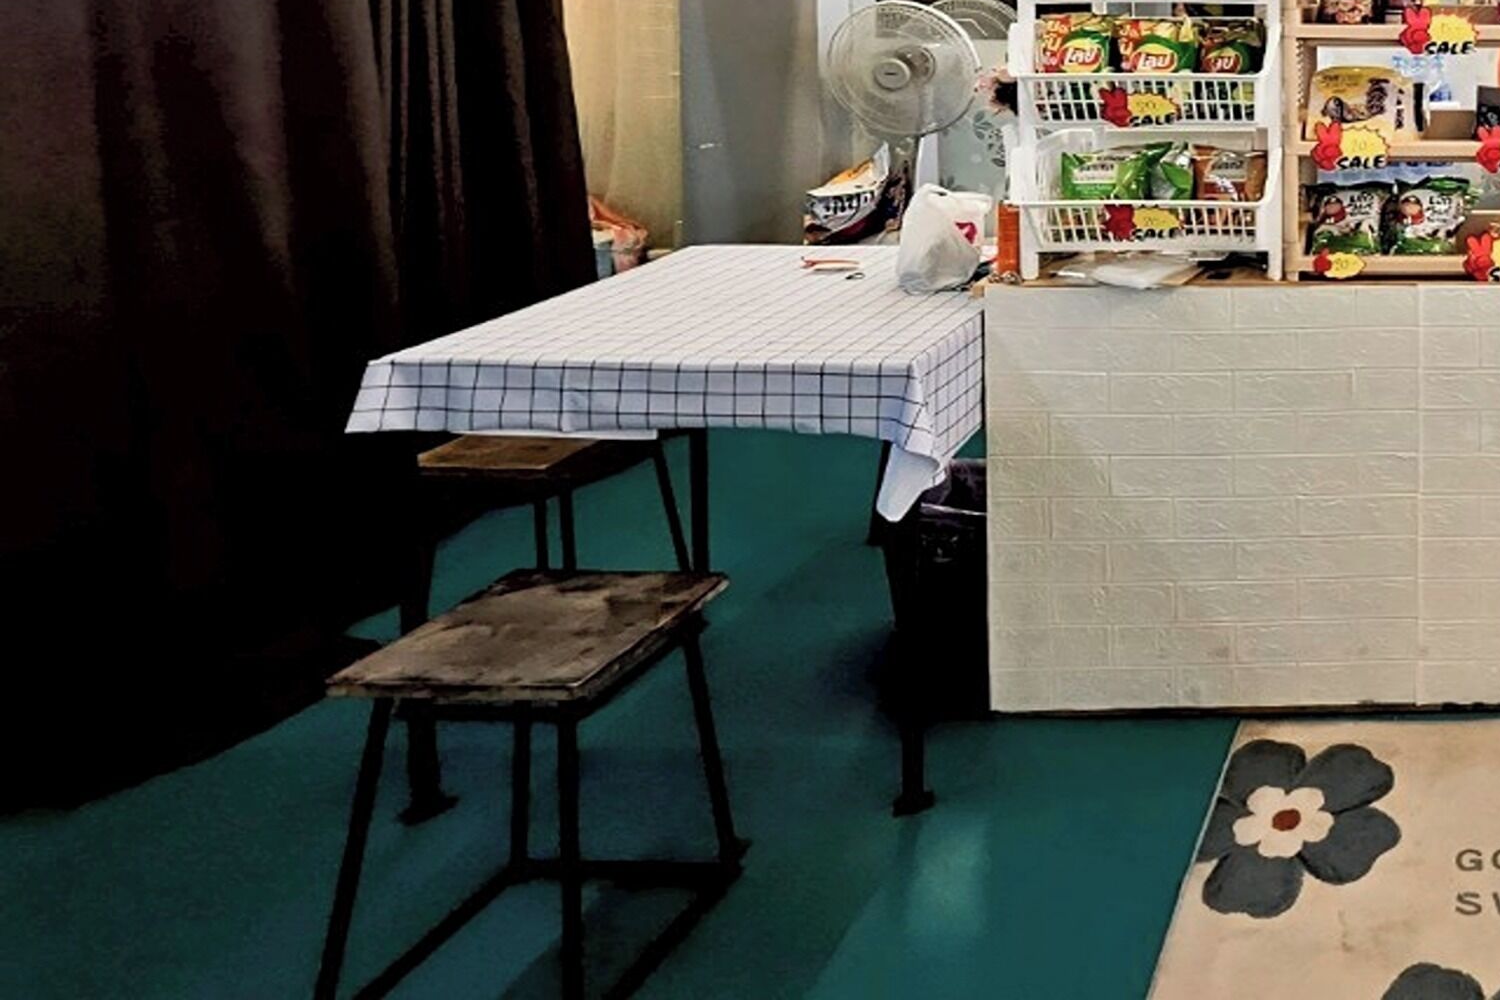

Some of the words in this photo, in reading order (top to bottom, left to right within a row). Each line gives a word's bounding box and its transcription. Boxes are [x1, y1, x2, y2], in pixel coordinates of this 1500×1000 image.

[1424, 41, 1474, 55] SALE
[1129, 112, 1176, 128] SALE
[1336, 154, 1387, 170] SALE
